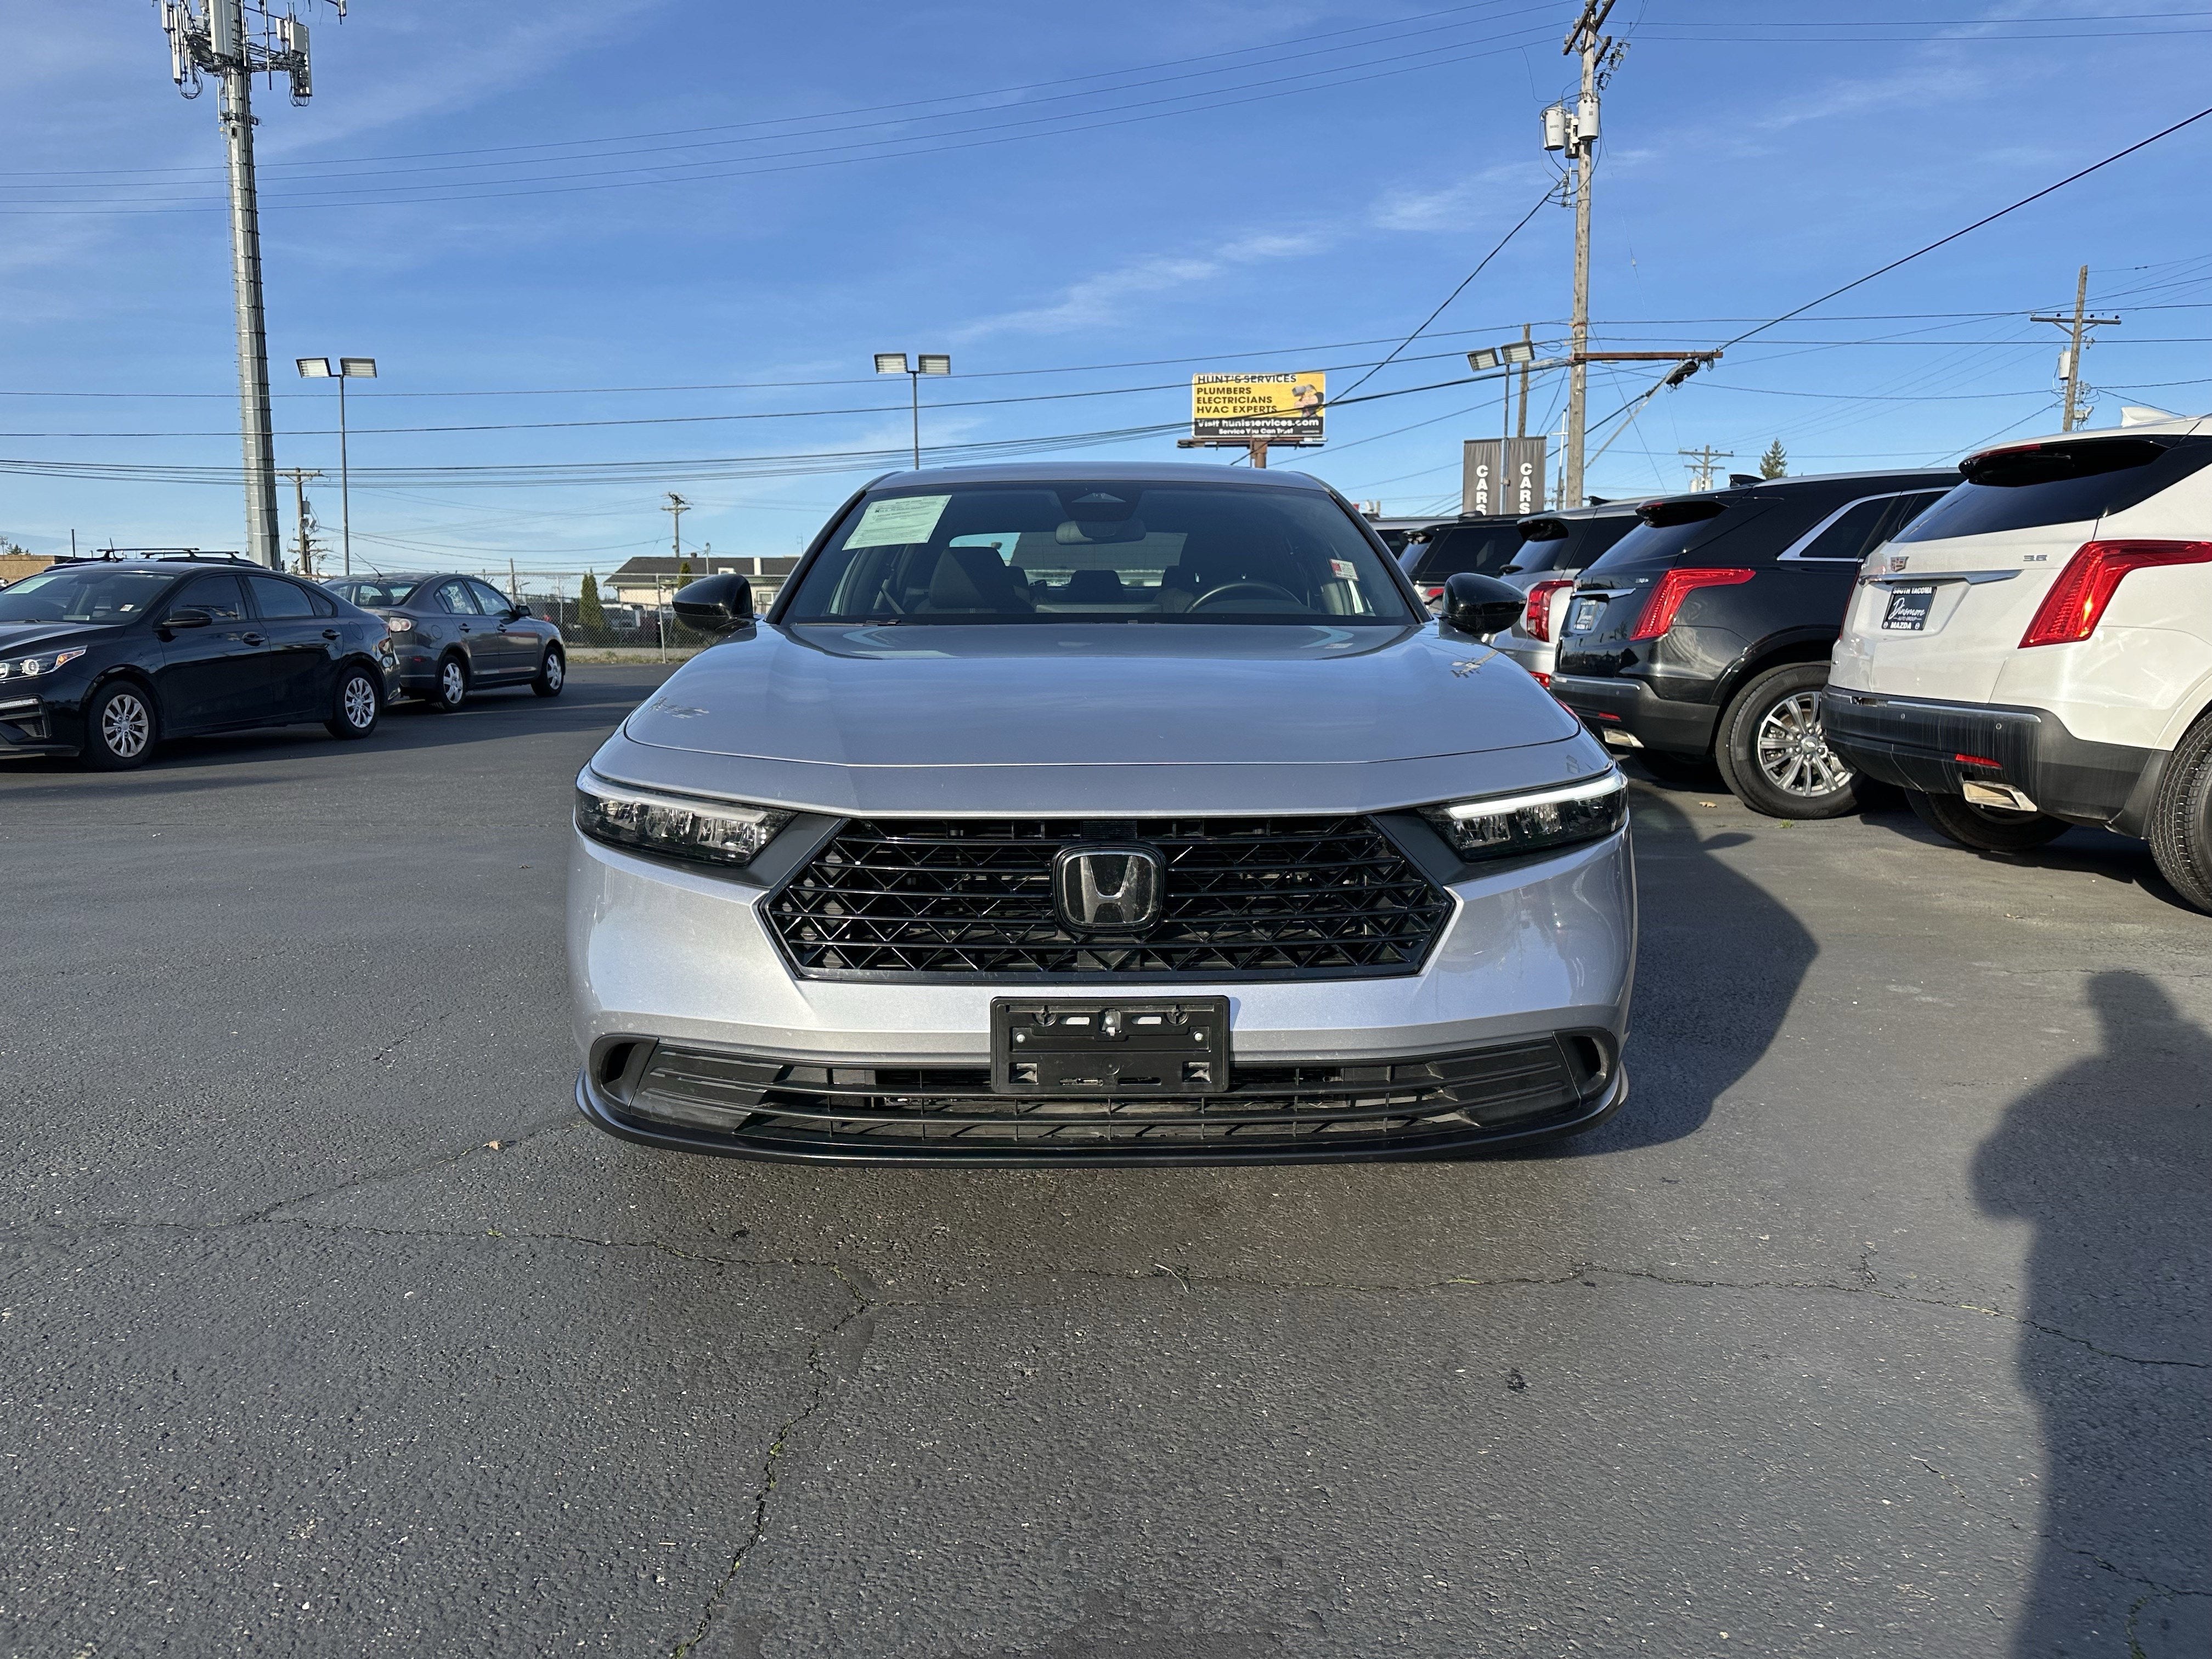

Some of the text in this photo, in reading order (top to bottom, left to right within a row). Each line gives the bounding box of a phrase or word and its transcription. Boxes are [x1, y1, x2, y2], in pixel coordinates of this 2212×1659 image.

[1197, 387, 1251, 395] PLUMBERS
[1198, 375, 1296, 383] HUNT'S SERVICES
[1476, 465, 1488, 516] CARS
[1520, 463, 1532, 514] CARS
